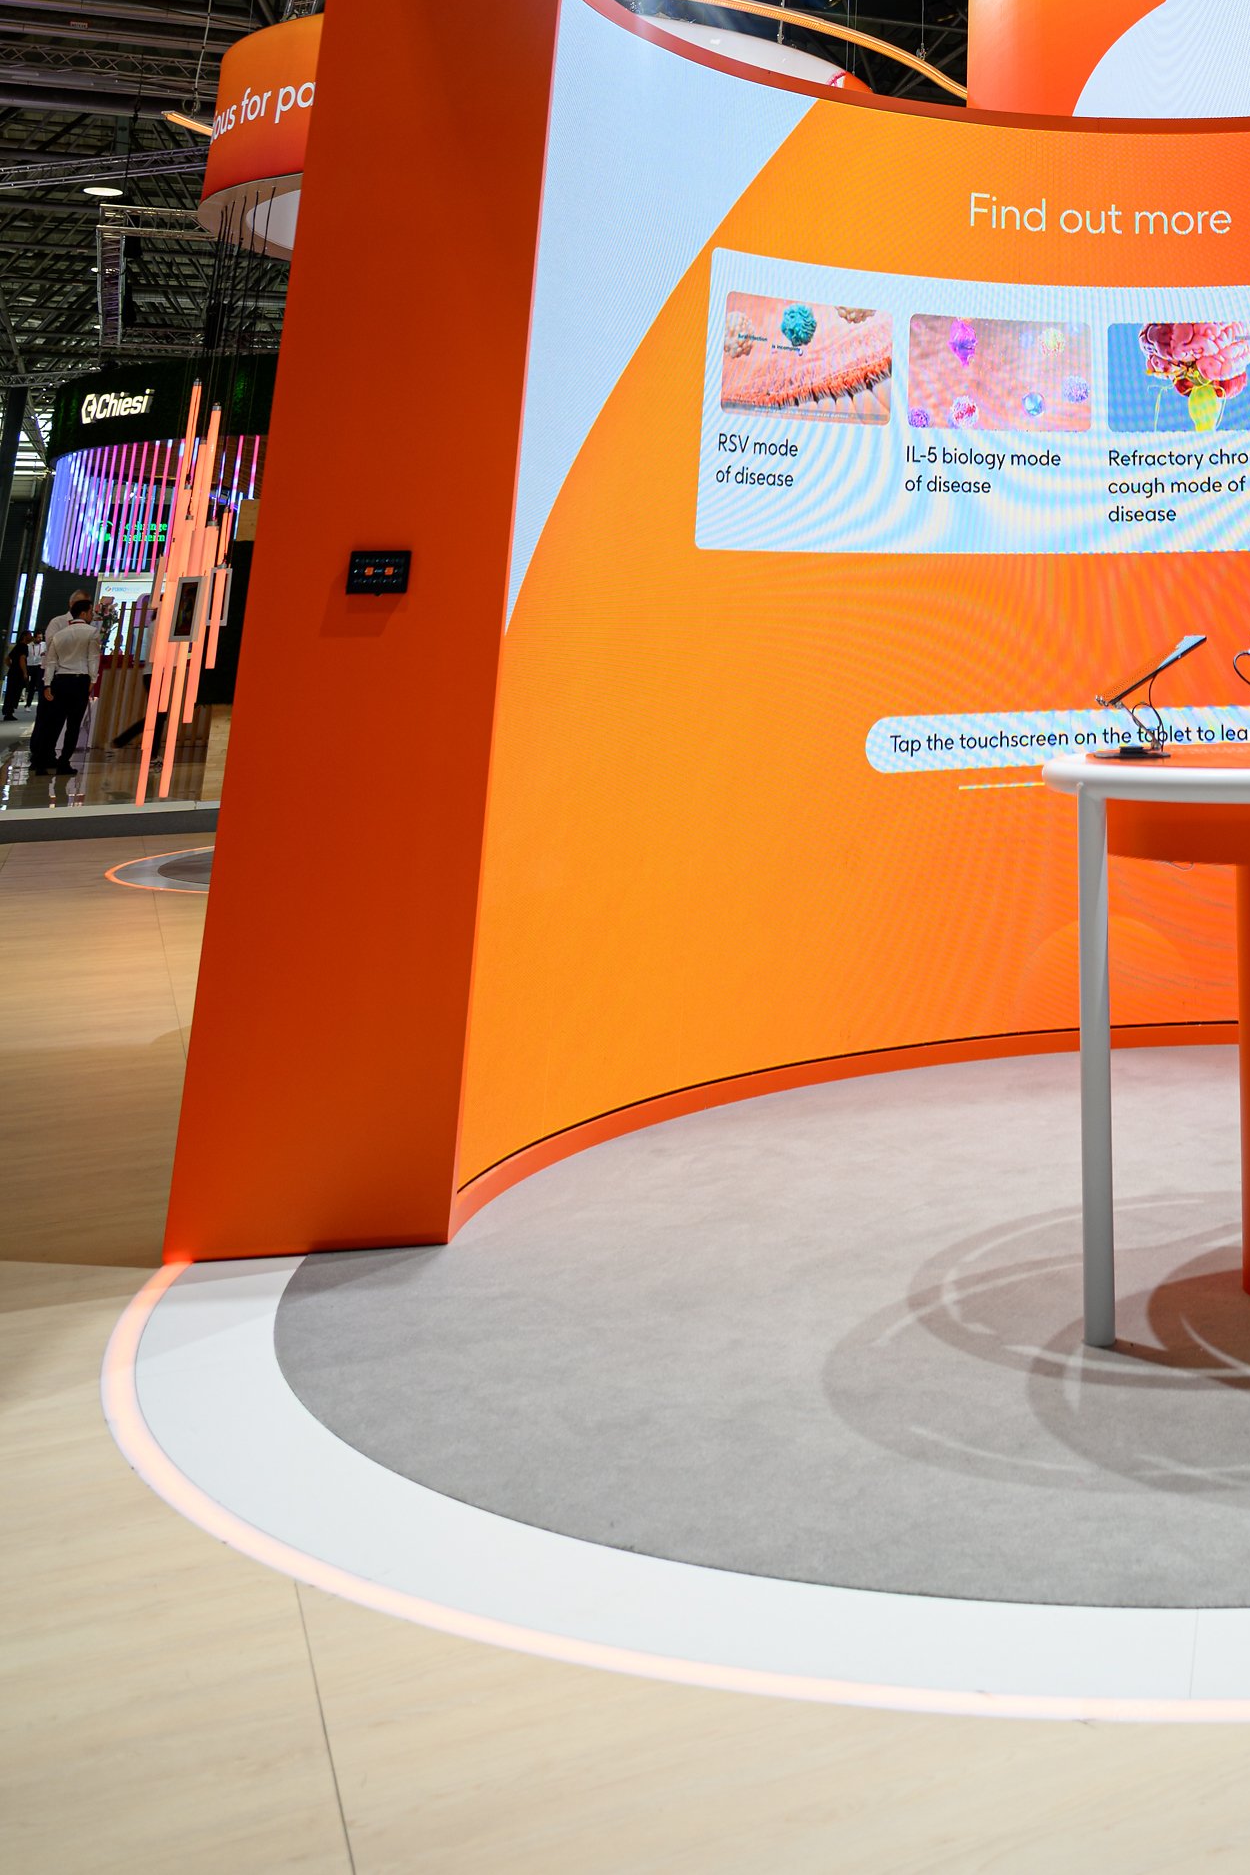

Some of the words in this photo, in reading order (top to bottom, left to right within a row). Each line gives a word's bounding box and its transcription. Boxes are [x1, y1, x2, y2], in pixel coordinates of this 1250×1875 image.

[240, 87, 272, 124] for
[970, 192, 1046, 232] Find
[1059, 203, 1123, 234] out
[1134, 210, 1232, 235] more
[96, 388, 149, 420] Chiesi
[718, 433, 749, 454] RSV
[753, 438, 798, 457] mode
[906, 445, 938, 464] IL-5
[942, 447, 1006, 470] biology
[1010, 449, 1062, 466] mode
[1108, 449, 1204, 470] Refractory
[715, 465, 732, 483] of
[734, 466, 794, 487] disease
[905, 475, 923, 492] of
[926, 475, 992, 493] disease
[1108, 477, 1165, 499] cough
[1170, 476, 1222, 494] mode
[1227, 475, 1246, 493] of
[1108, 505, 1177, 522] disease
[890, 734, 922, 757] Tap
[926, 733, 954, 752] the
[959, 731, 1069, 750] touchscreen
[1074, 731, 1097, 745] on
[1102, 727, 1132, 744] the
[1137, 725, 1192, 743] tablet
[1197, 726, 1215, 742] to
